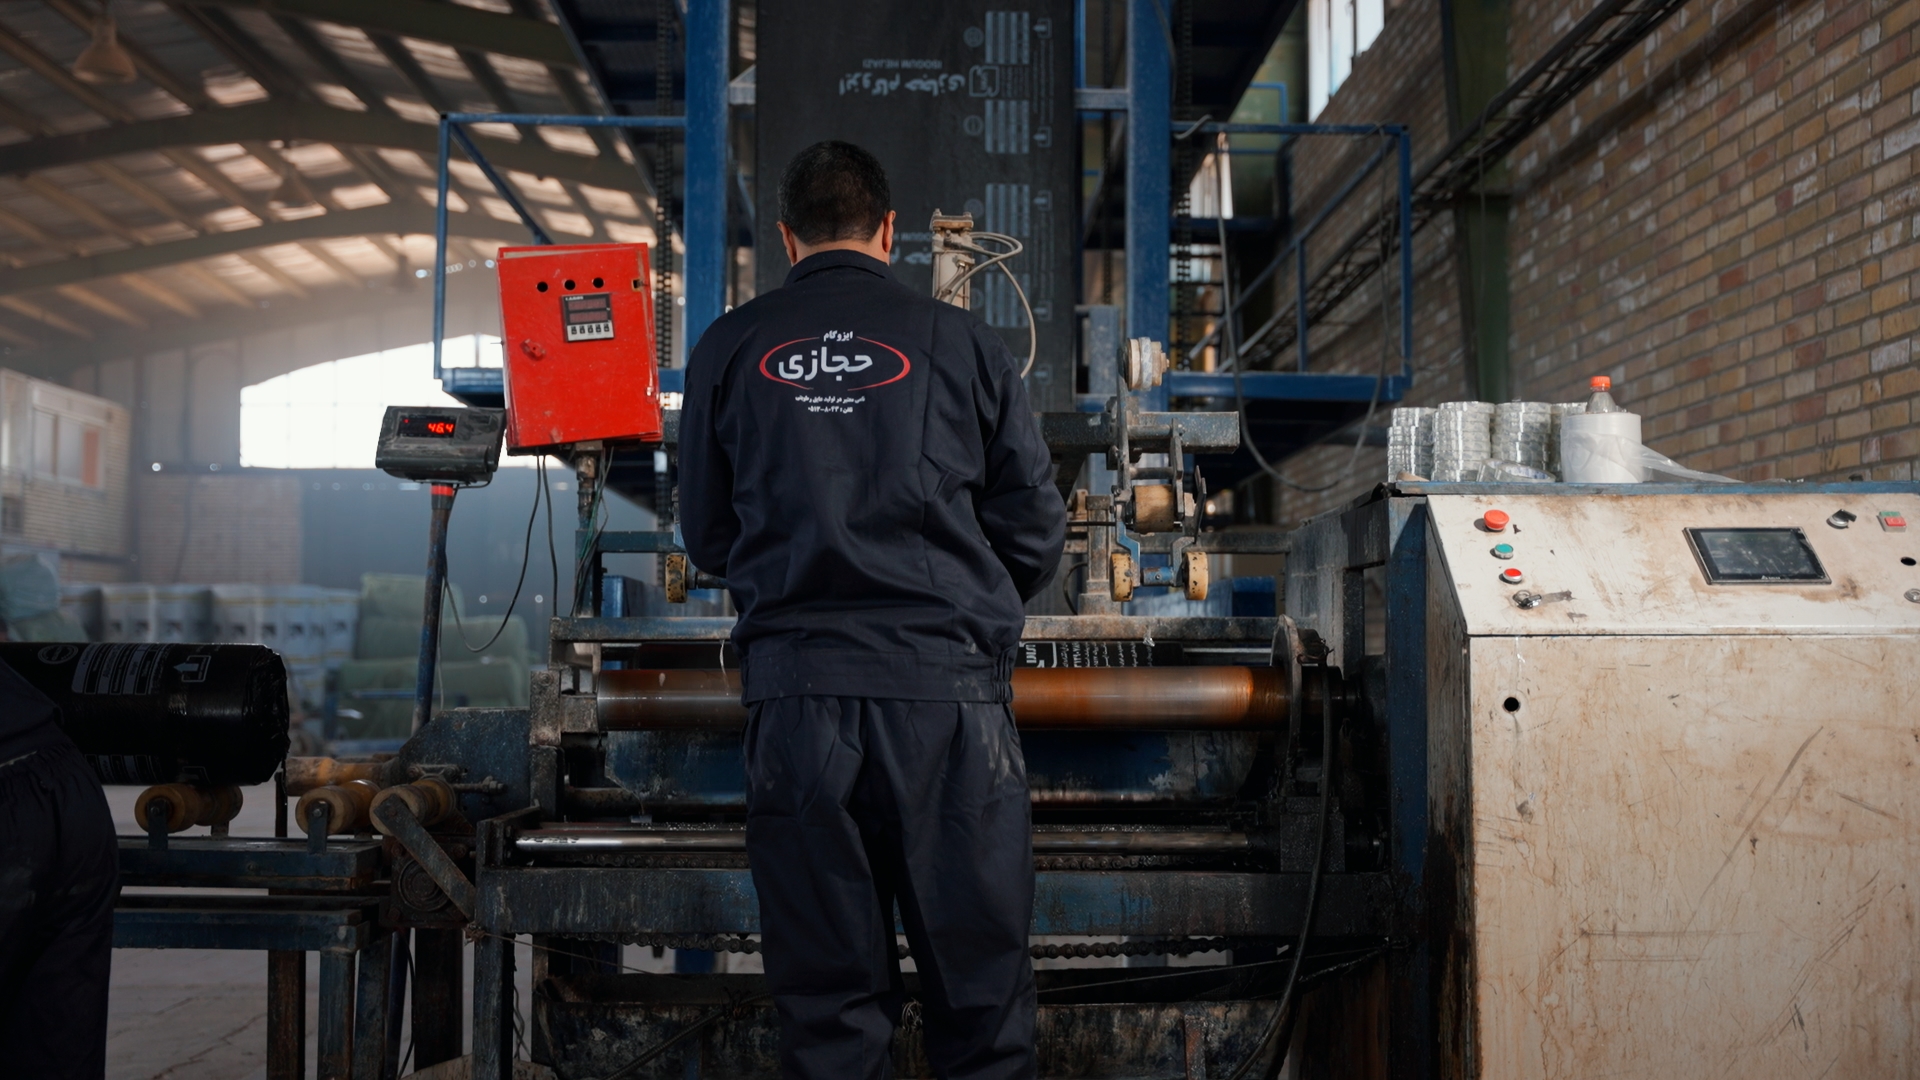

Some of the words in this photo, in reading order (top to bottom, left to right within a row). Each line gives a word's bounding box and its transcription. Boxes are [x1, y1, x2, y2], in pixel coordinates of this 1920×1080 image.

[838, 72, 901, 97] ایزوگام
[904, 73, 966, 97] حجازی
[823, 330, 854, 342] ایزوگام
[778, 346, 873, 381] حجازی
